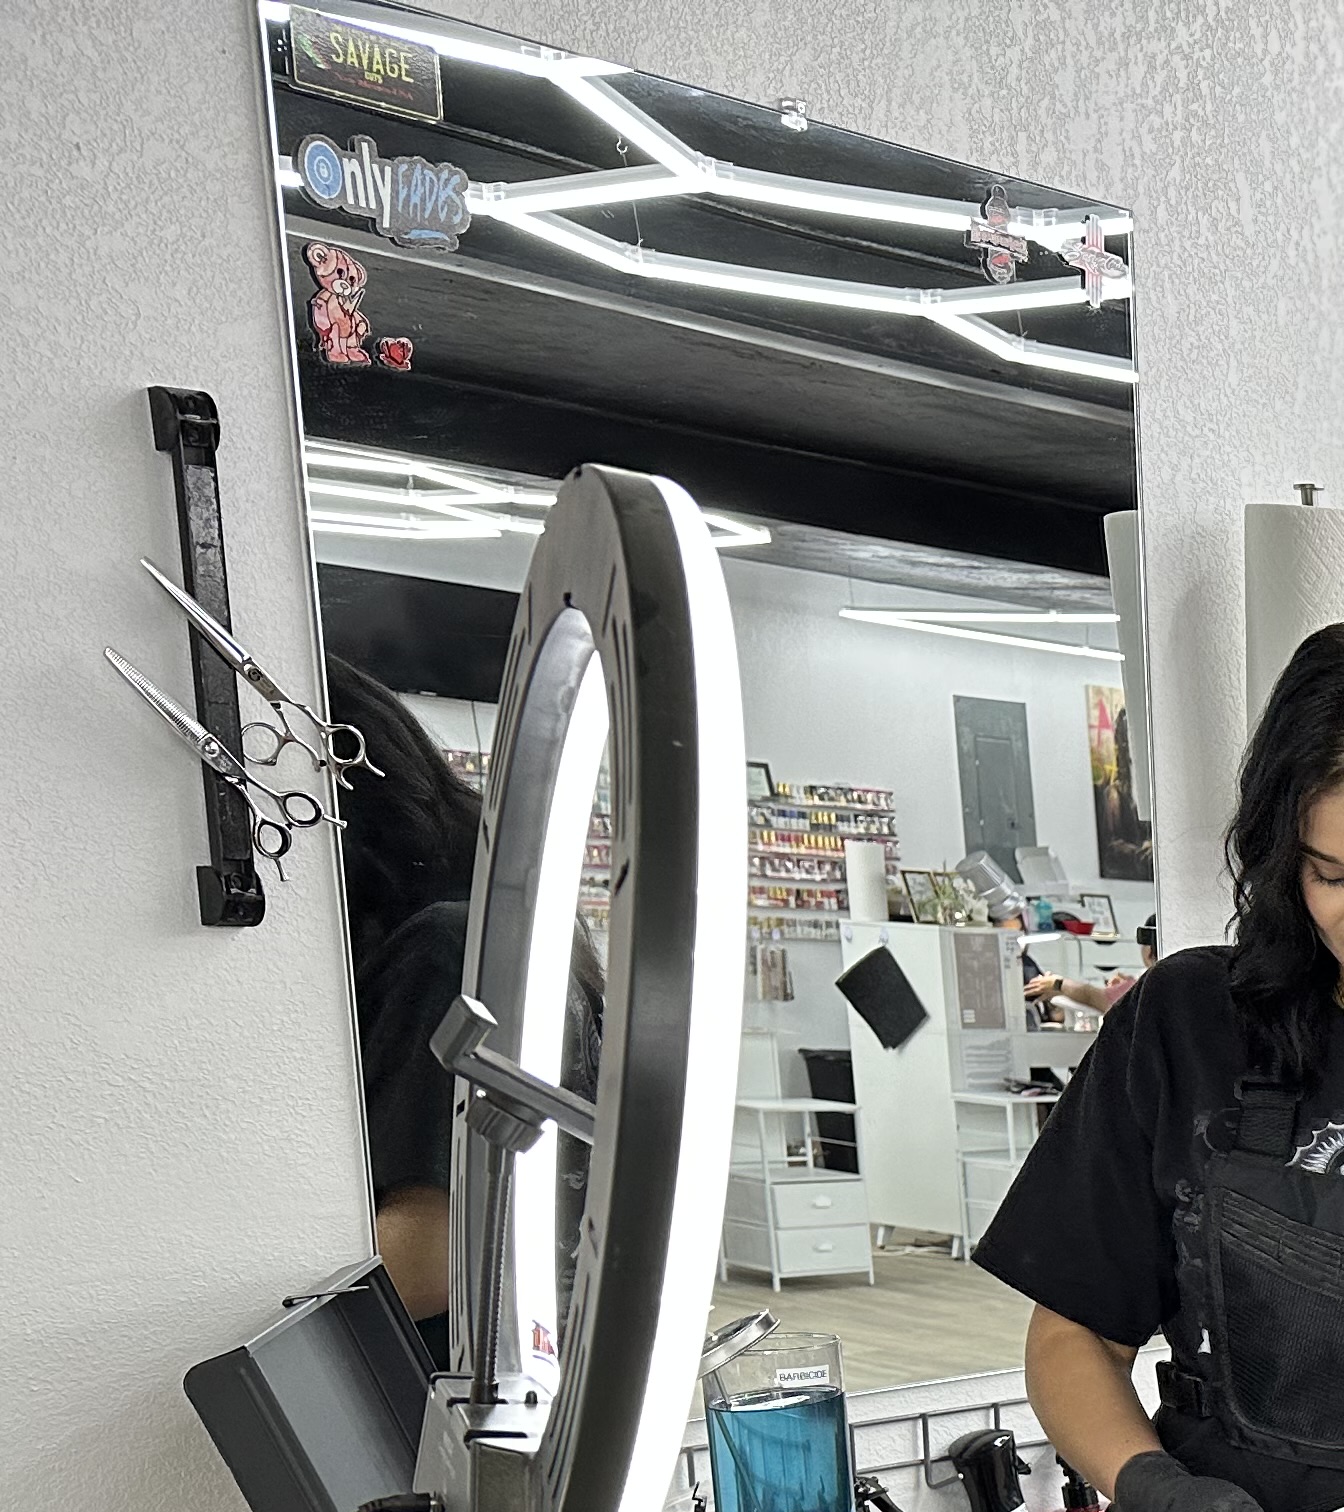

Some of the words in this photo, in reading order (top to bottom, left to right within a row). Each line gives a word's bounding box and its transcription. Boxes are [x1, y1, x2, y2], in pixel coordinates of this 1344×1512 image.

[330, 32, 414, 83] SAVAGE
[304, 140, 392, 228] Only
[397, 163, 463, 225] FADES
[779, 1369, 827, 1382] BARBICIDE
